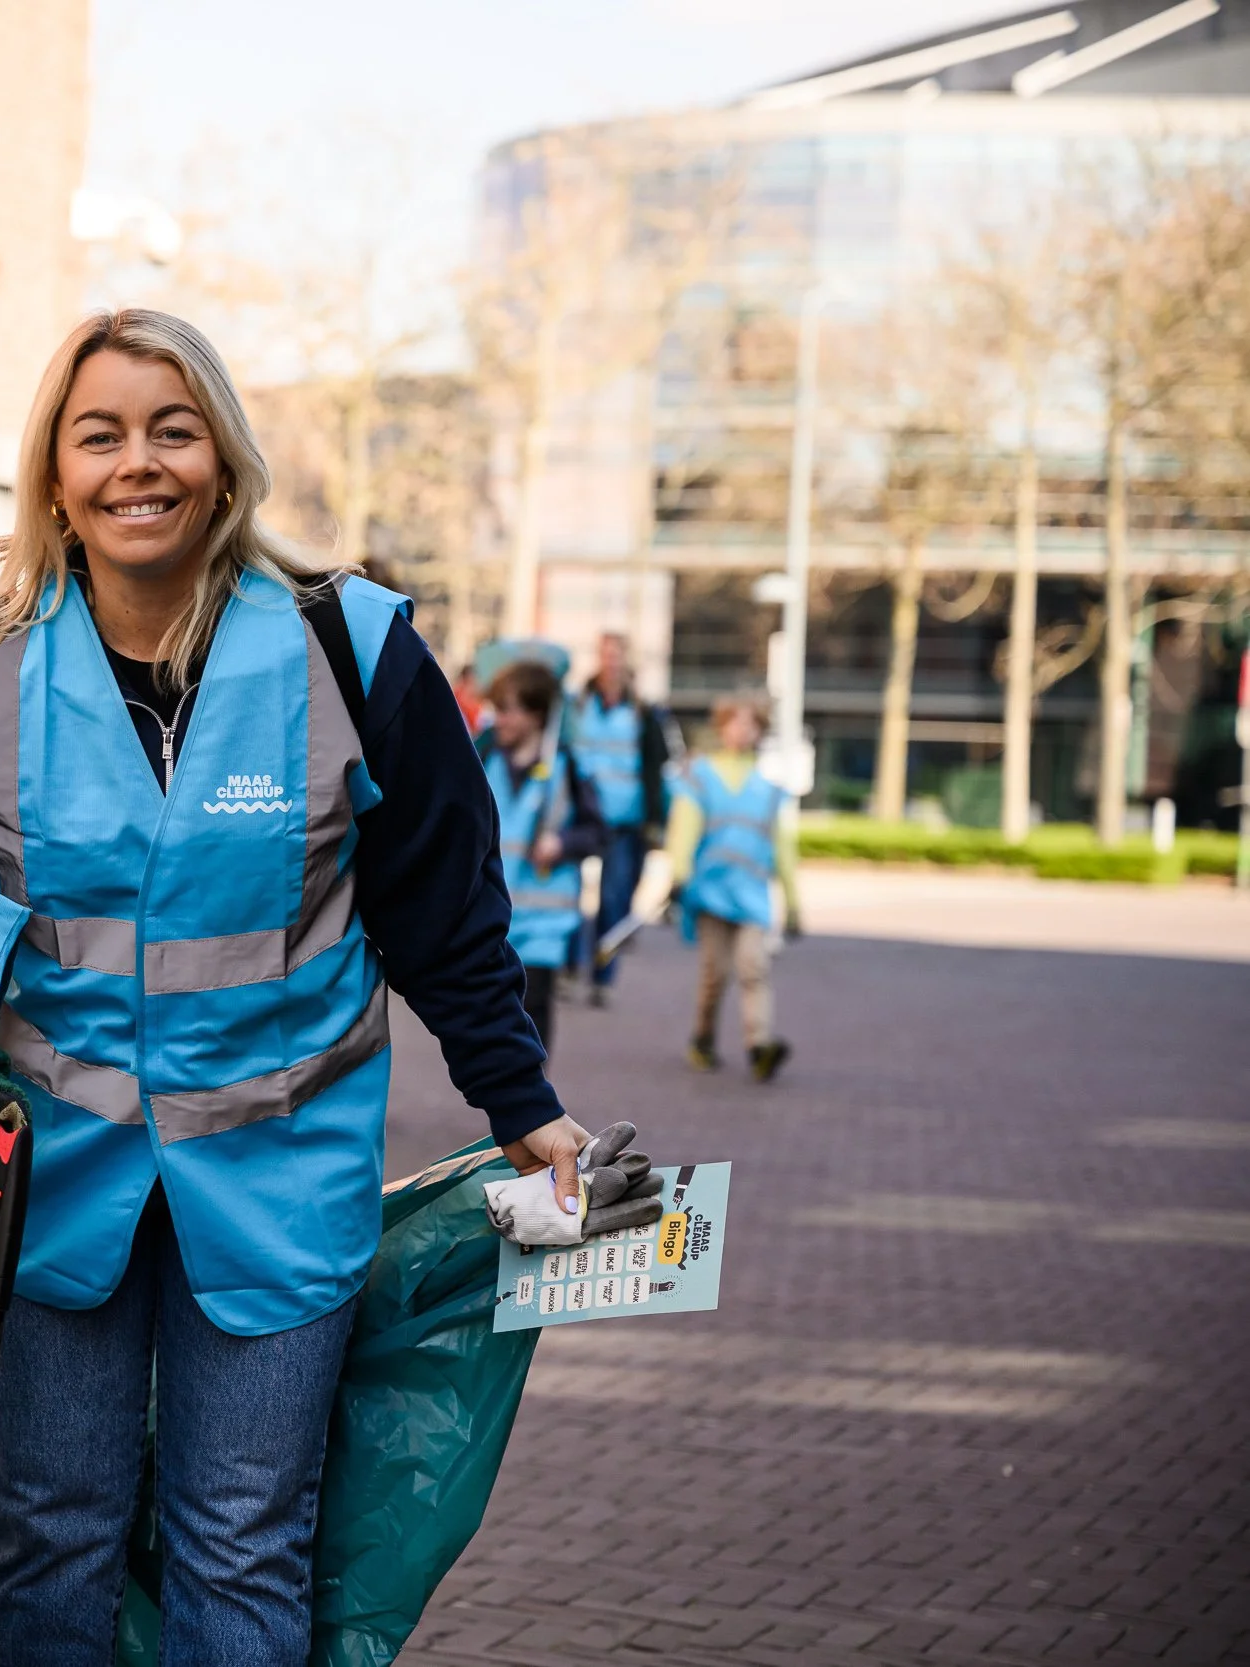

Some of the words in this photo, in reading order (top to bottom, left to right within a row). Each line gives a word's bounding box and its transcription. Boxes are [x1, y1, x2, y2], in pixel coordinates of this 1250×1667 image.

[216, 786, 284, 798] CLEANUP
[228, 775, 272, 787] MAAS
[663, 1221, 681, 1258] Bingo
[690, 1214, 703, 1261] CLEANUP
[700, 1221, 712, 1252] MAAS
[606, 1248, 616, 1271] BLIKJE
[639, 1244, 647, 1268] PLASTIC
[547, 1286, 556, 1313] ZAKDOEK
[632, 1276, 641, 1303] CHIPSZAK
